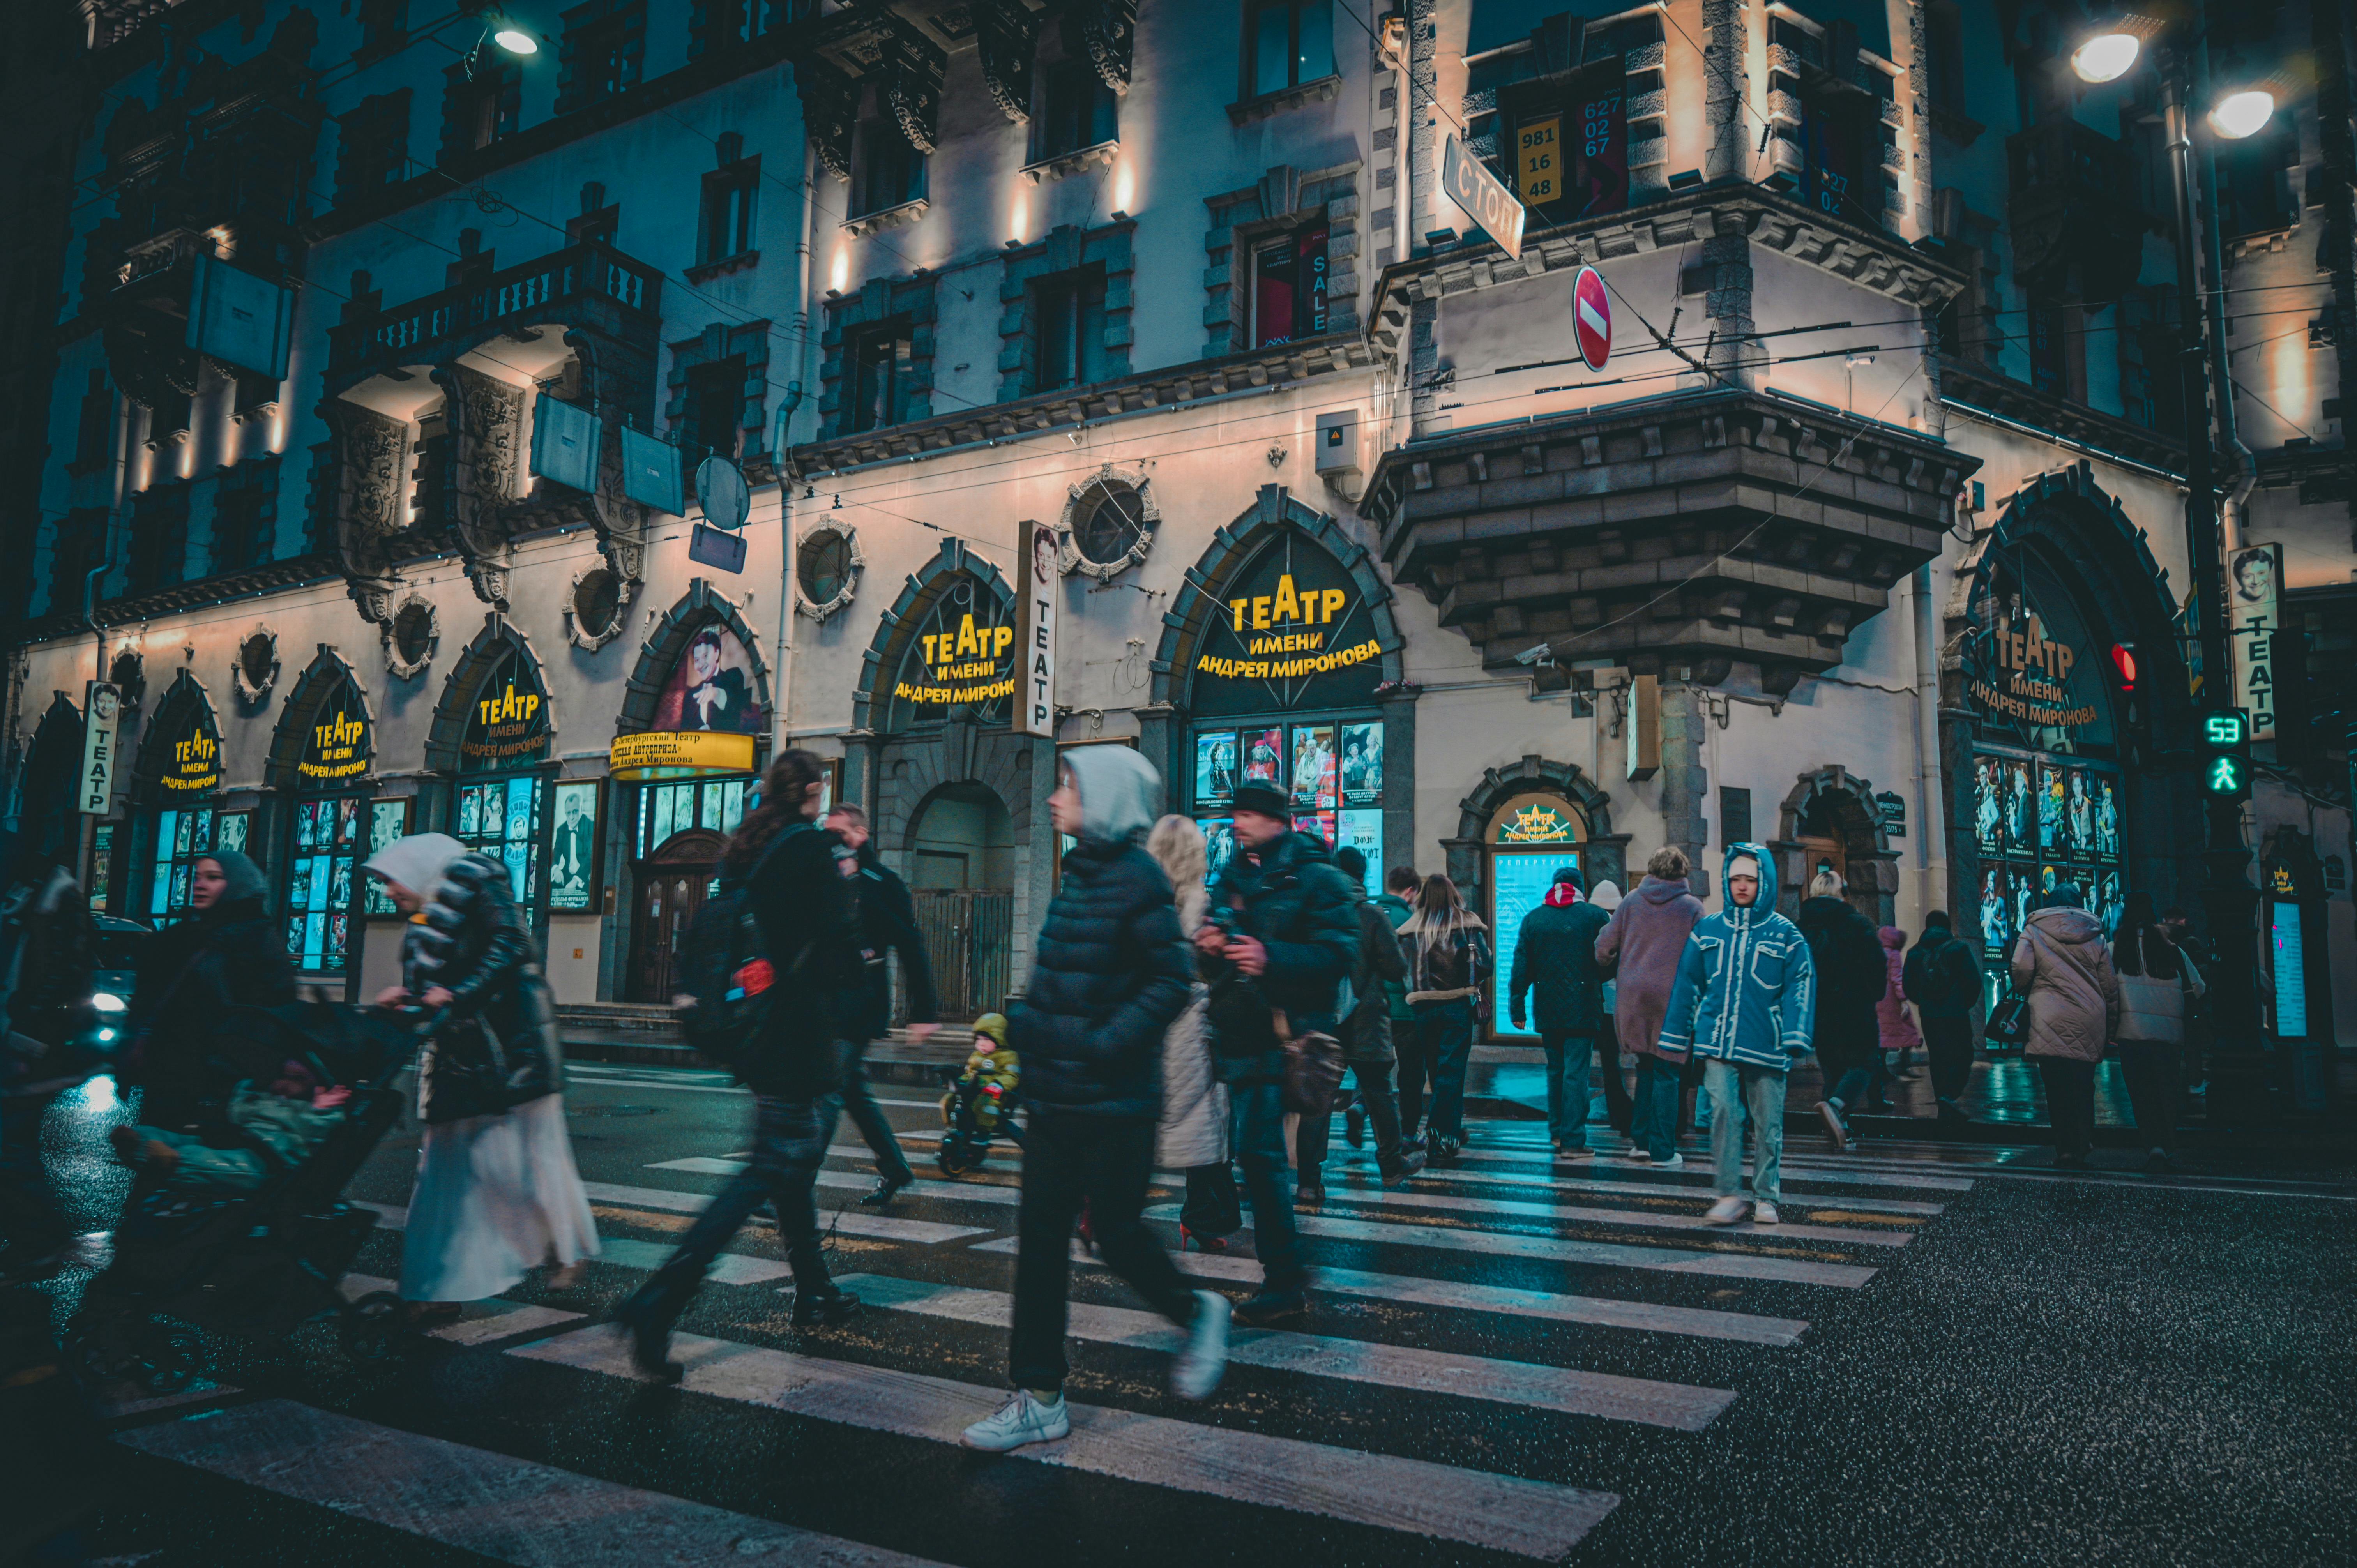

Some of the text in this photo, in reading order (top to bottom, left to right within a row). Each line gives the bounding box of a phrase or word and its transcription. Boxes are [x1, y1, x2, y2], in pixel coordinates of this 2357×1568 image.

[1585, 96, 1621, 119] 627
[1522, 128, 1555, 149] 981
[1585, 119, 1609, 138] 02
[1586, 137, 1610, 157] 67
[1529, 154, 1550, 173] 16
[1458, 160, 1514, 235] СТОП
[1529, 179, 1551, 197] 48
[1266, 259, 1291, 268] КВАРТИРУ
[1313, 256, 1326, 331] SALE
[1229, 574, 1346, 632] ТЕАТР
[922, 613, 1013, 665] ТЕАТР
[1249, 632, 1323, 655] ИМЕНИ
[1996, 611, 2073, 679] ТЕАТР
[1034, 600, 1049, 726] ТЕАТР
[1197, 639, 1382, 679] АНДРЕЯ МИРОНОВА
[937, 661, 995, 681] ИМЕНИ
[2246, 616, 2274, 734] ТЕАТР
[894, 682, 952, 704] АНДРЕЯ
[2010, 677, 2063, 702] ИМЕНИ
[480, 684, 539, 725] ТЕАТР
[1970, 680, 2097, 726] АНДРЕЯ МИРОНОВА
[316, 711, 363, 748] ТЕАТР
[489, 723, 525, 738] ИМЕНИ
[675, 731, 700, 744] Театр
[2209, 718, 2239, 742] 53
[460, 741, 498, 757] АНДРЕЯ
[633, 743, 682, 755] АНТРЕПРИЗА»
[89, 729, 110, 809] ТЕАТР
[181, 761, 209, 773] ИМЕНИ
[298, 762, 329, 778] АНДРЕЯ
[620, 757, 643, 767] Андрея
[646, 754, 693, 765] Миронова
[161, 775, 187, 790] АНДРЕЯ
[1517, 806, 1556, 826] ТЕАТР
[1505, 830, 1568, 841] АНДРЕЯ МИРОНОВА
